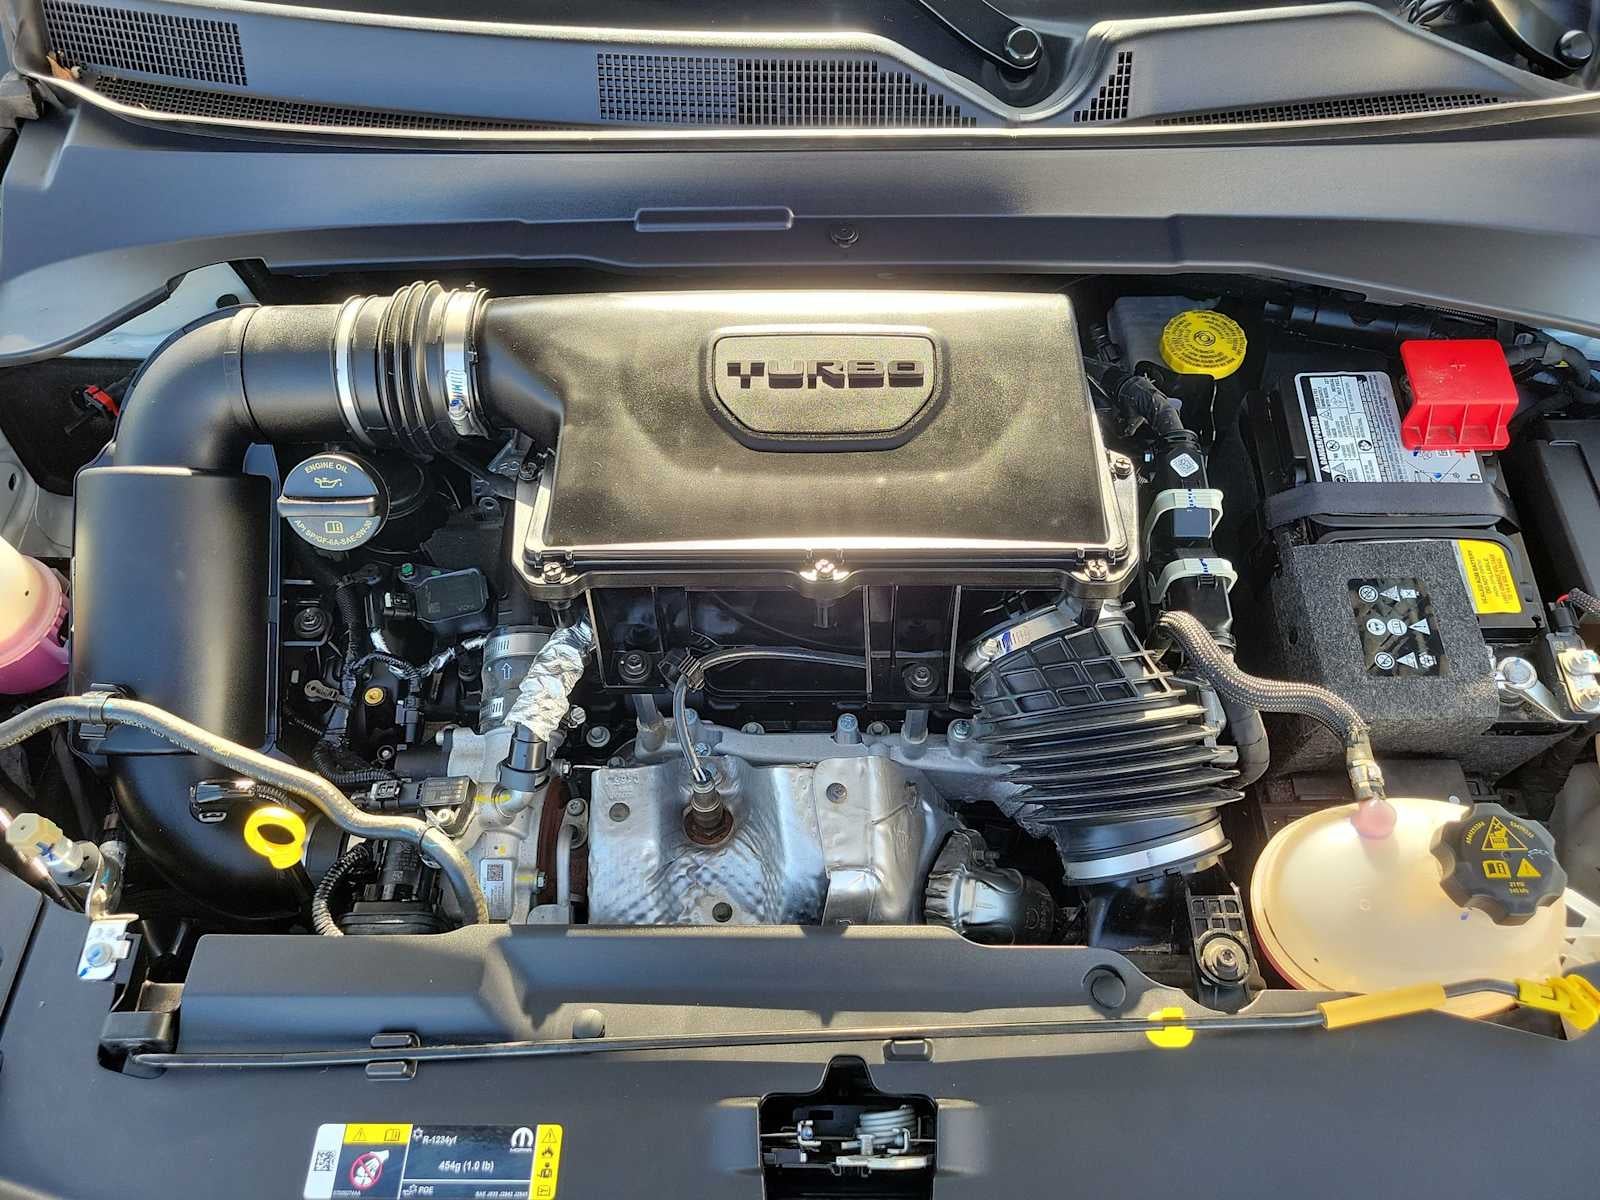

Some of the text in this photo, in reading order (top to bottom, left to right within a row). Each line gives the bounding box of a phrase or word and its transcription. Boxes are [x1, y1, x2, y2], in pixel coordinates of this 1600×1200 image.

[726, 360, 925, 389] TURBO
[304, 462, 350, 474] ENGINE OIL
[422, 1135, 458, 1146] R-1234yf
[438, 1160, 495, 1174] 454g (1.0 lb)
